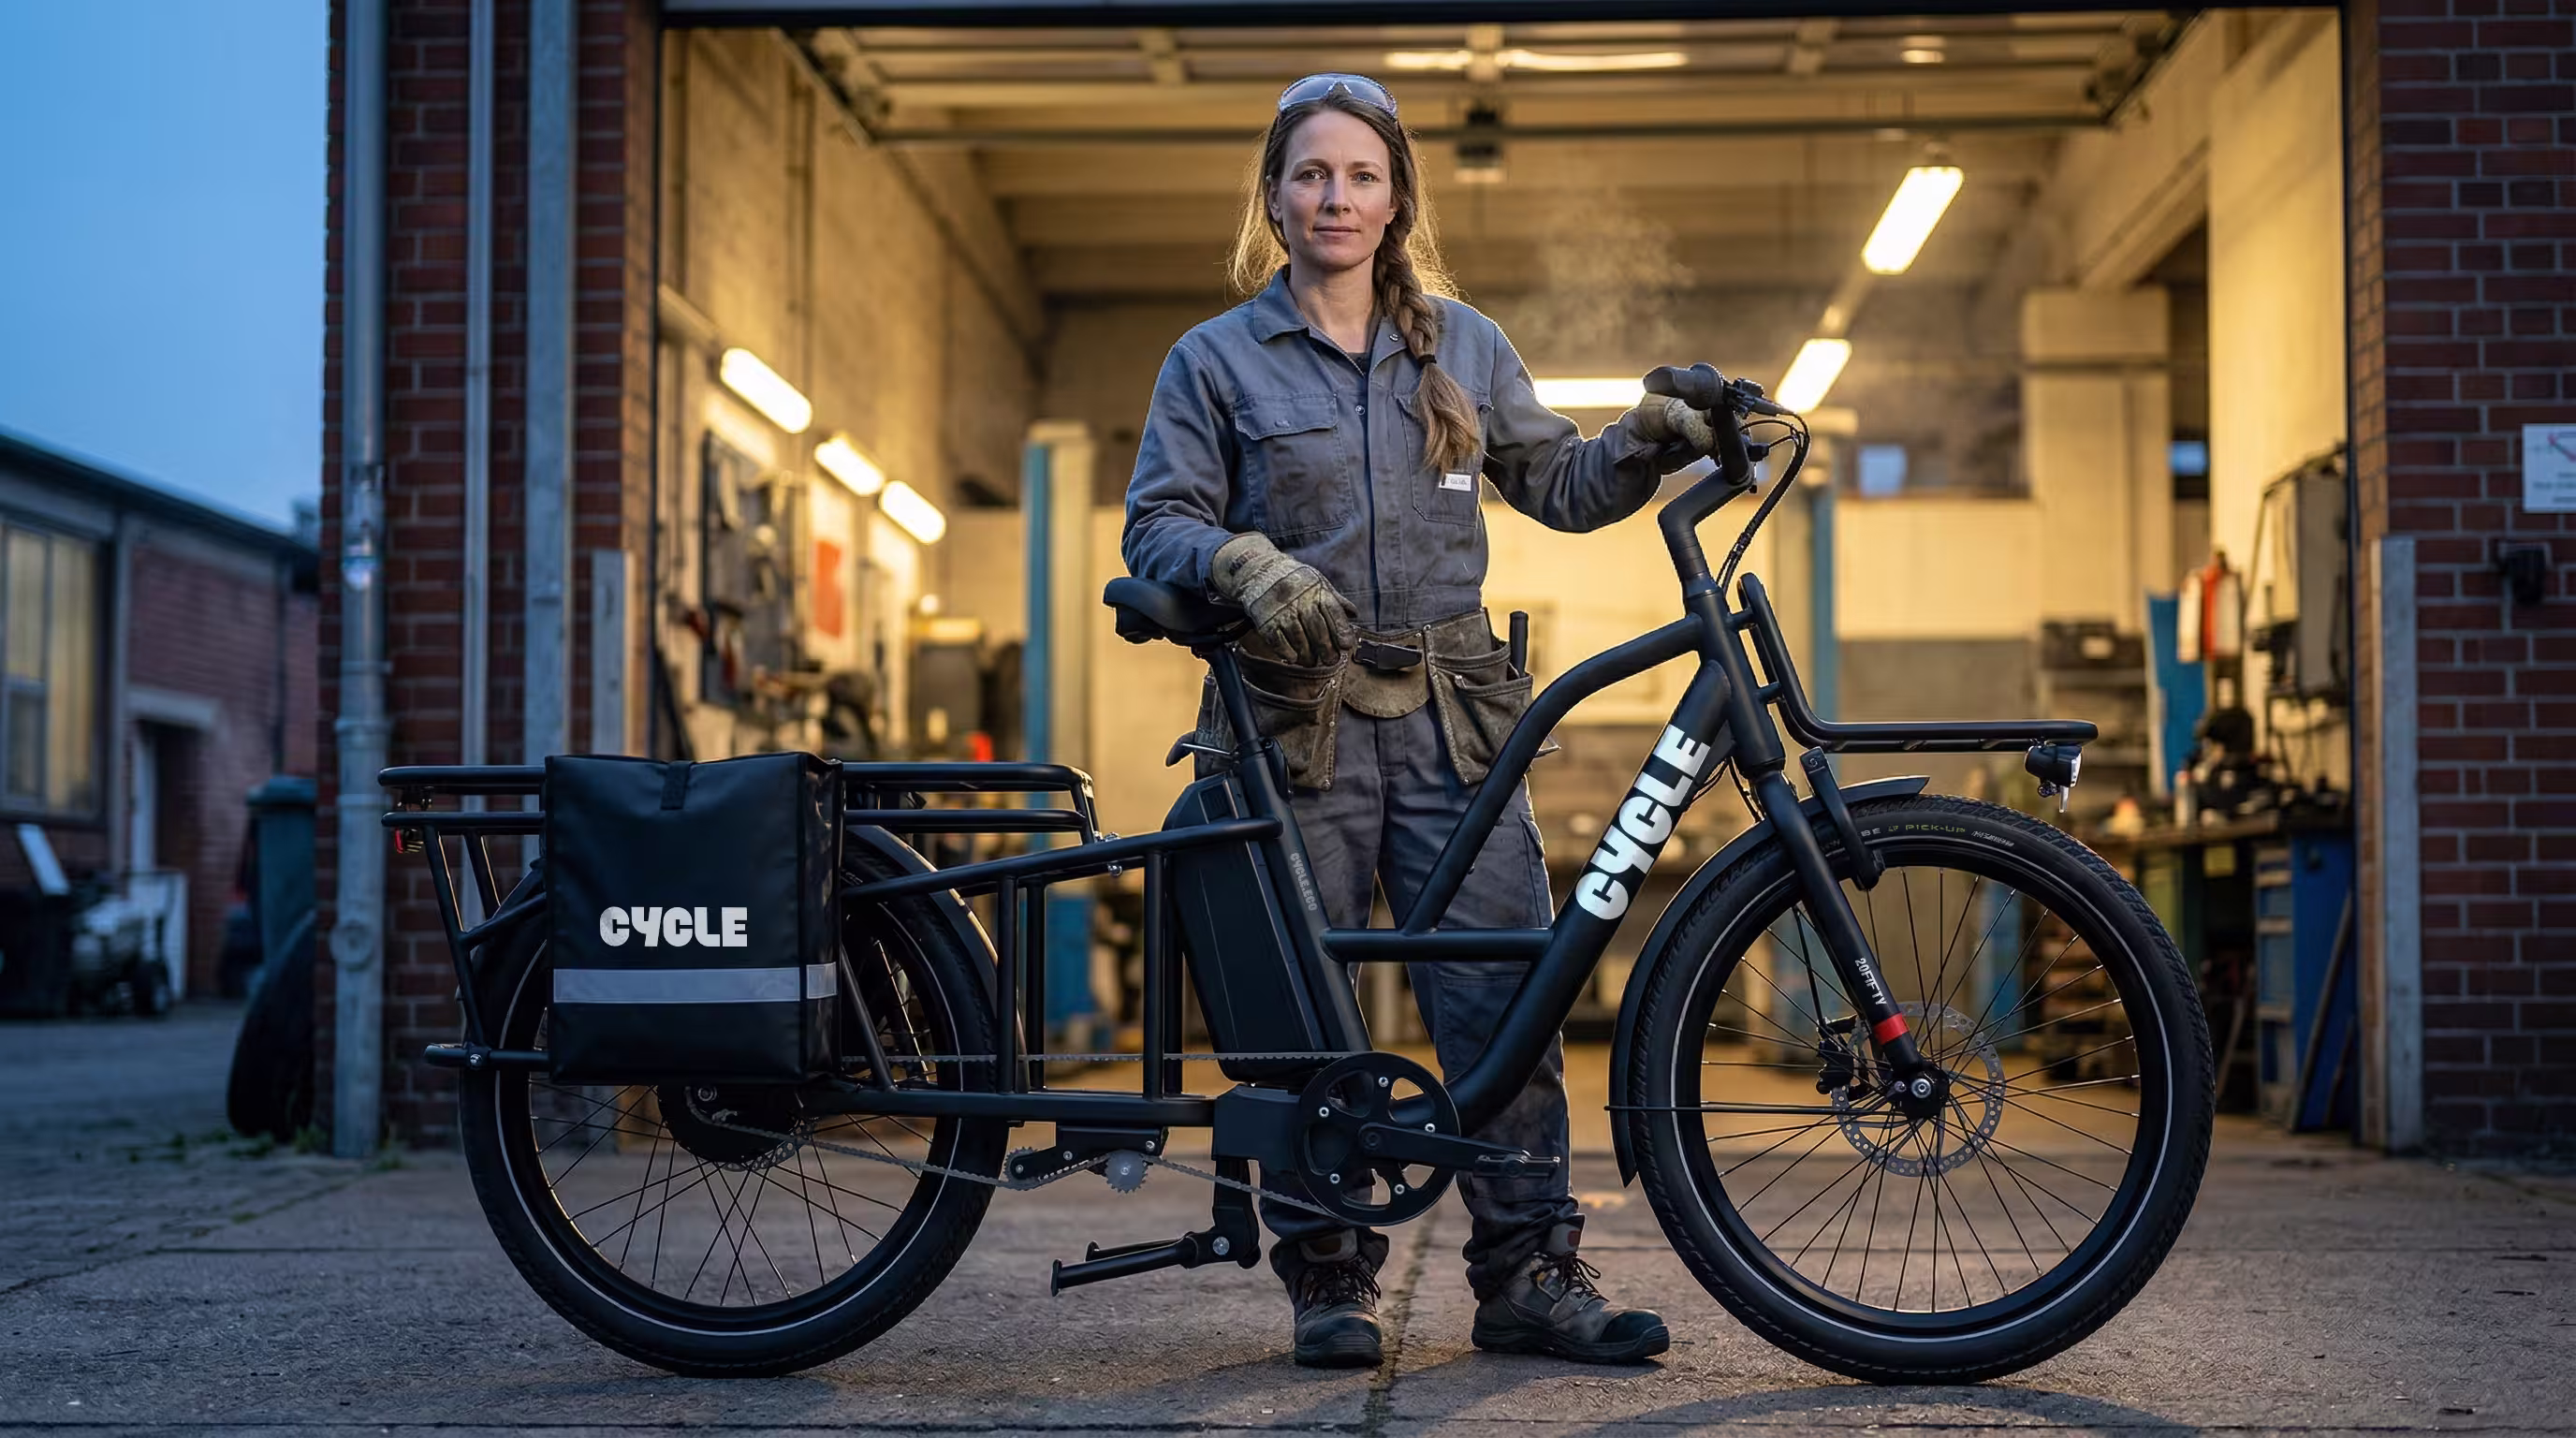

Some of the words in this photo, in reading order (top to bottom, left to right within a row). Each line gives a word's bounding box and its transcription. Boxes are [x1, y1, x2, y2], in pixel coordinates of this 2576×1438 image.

[1575, 724, 1711, 920] CYCLE
[1905, 824, 1967, 833] PICK-UP
[1290, 852, 1318, 911] CYCLE.ECO
[600, 906, 748, 947] CYCLE
[1854, 958, 1887, 1005] 20FIFTY
